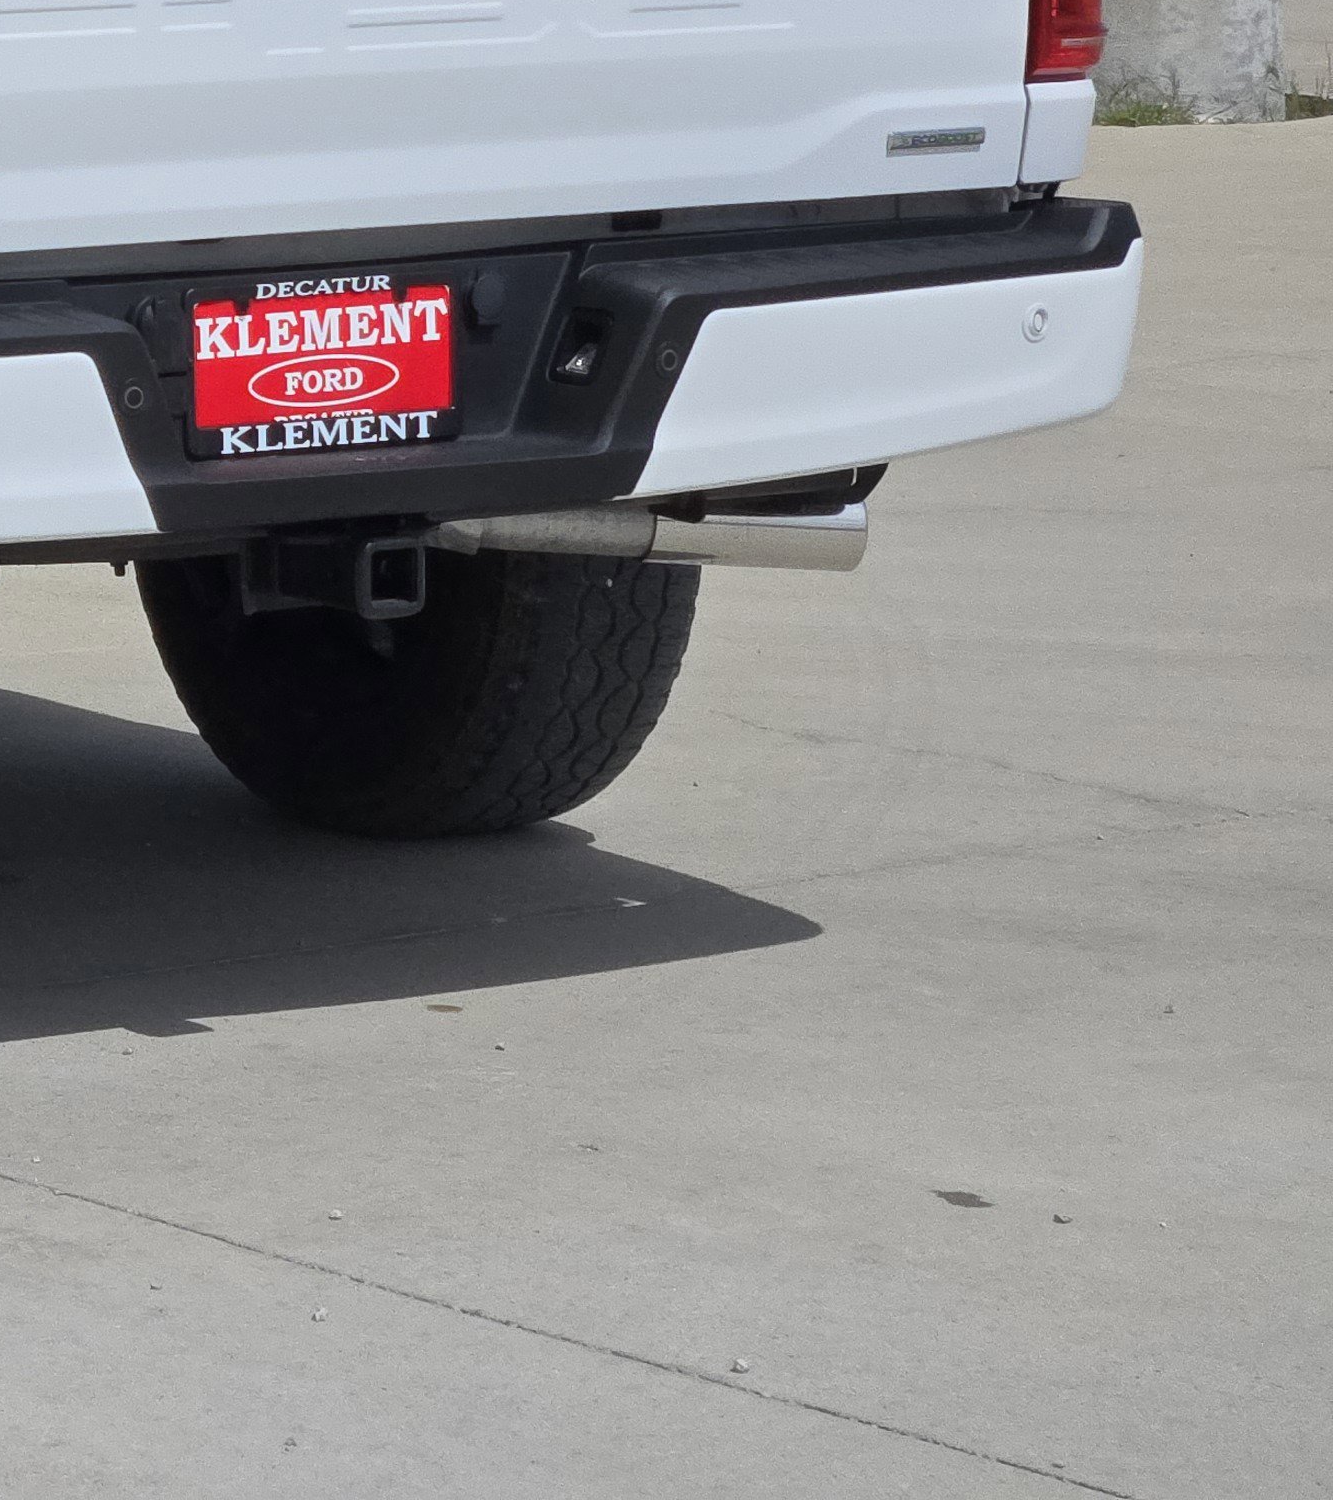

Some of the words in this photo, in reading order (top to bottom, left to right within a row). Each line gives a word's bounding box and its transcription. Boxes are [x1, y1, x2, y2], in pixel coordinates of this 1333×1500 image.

[255, 274, 391, 300] DECATUR
[194, 297, 448, 361] KLEMENT
[284, 366, 364, 396] FORD
[220, 410, 438, 455] KLEMENT
